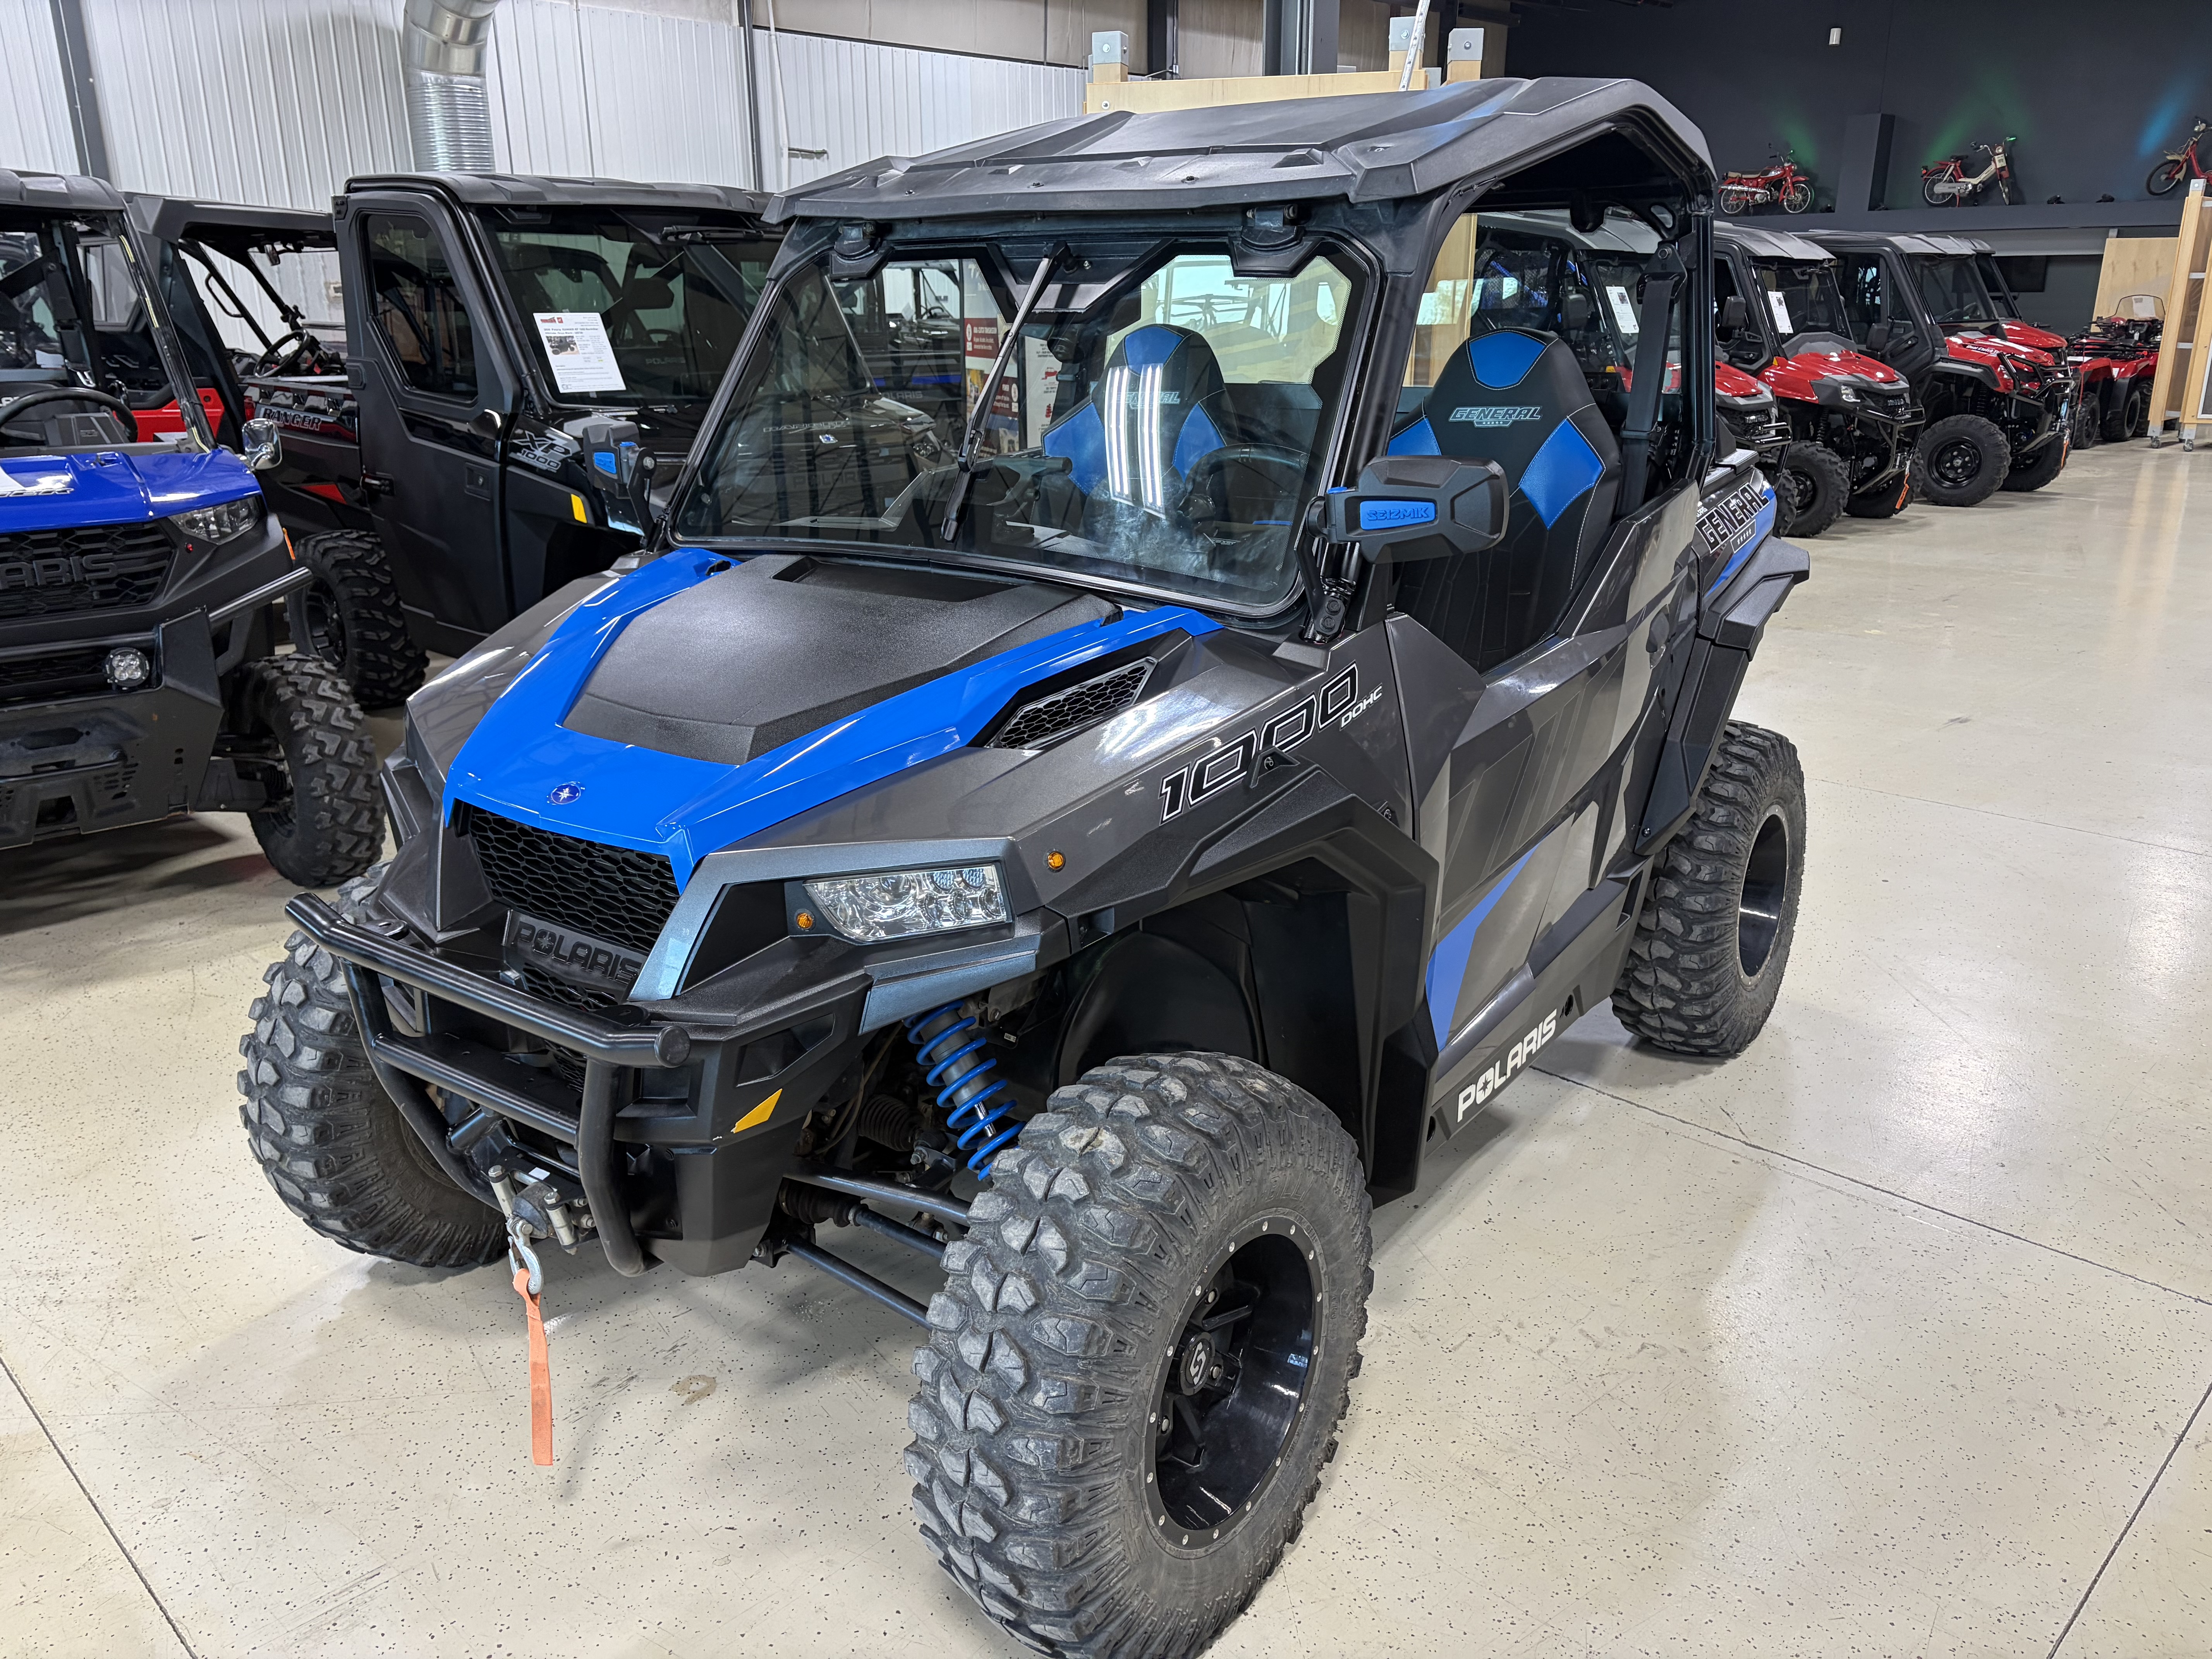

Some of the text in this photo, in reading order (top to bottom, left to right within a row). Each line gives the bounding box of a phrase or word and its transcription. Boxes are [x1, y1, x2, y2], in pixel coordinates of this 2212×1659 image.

[881, 390, 923, 400] OLARIS
[259, 407, 322, 431] RANGER
[1449, 406, 1542, 421] GENERAL
[512, 430, 572, 457] XP
[521, 448, 561, 470] 1000
[1367, 506, 1430, 522] SEIZMIK
[1695, 482, 1770, 554] GENERAL
[1159, 660, 1382, 826] 1000 DOHC
[512, 920, 644, 984] POLARIS
[1456, 1008, 1558, 1123] POLARIS
